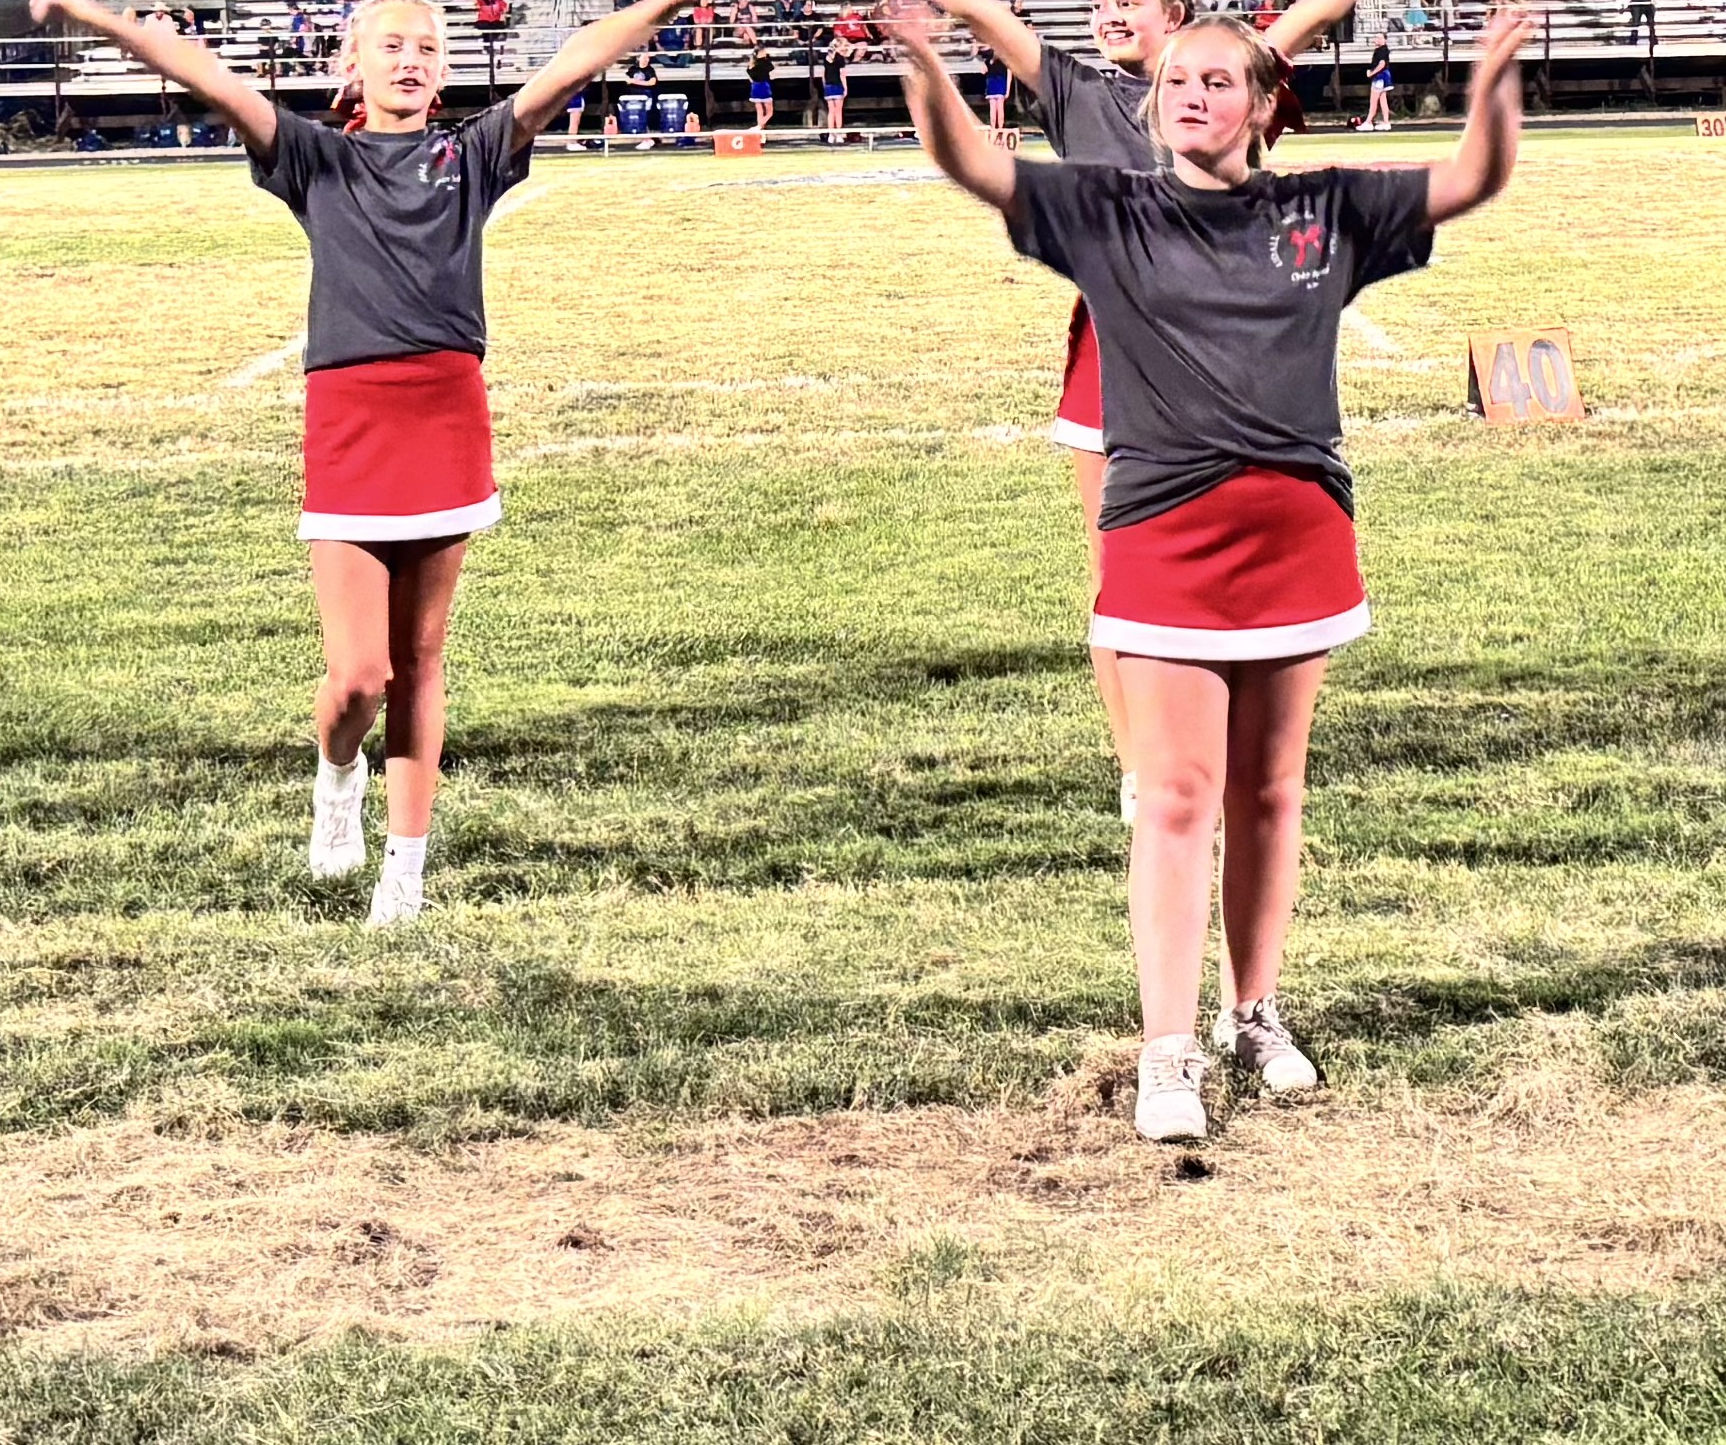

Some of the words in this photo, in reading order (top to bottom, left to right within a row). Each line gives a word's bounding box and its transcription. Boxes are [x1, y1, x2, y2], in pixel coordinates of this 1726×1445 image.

[1701, 118, 1725, 137] 30
[993, 131, 1017, 151] 40
[1488, 338, 1570, 419] 40
